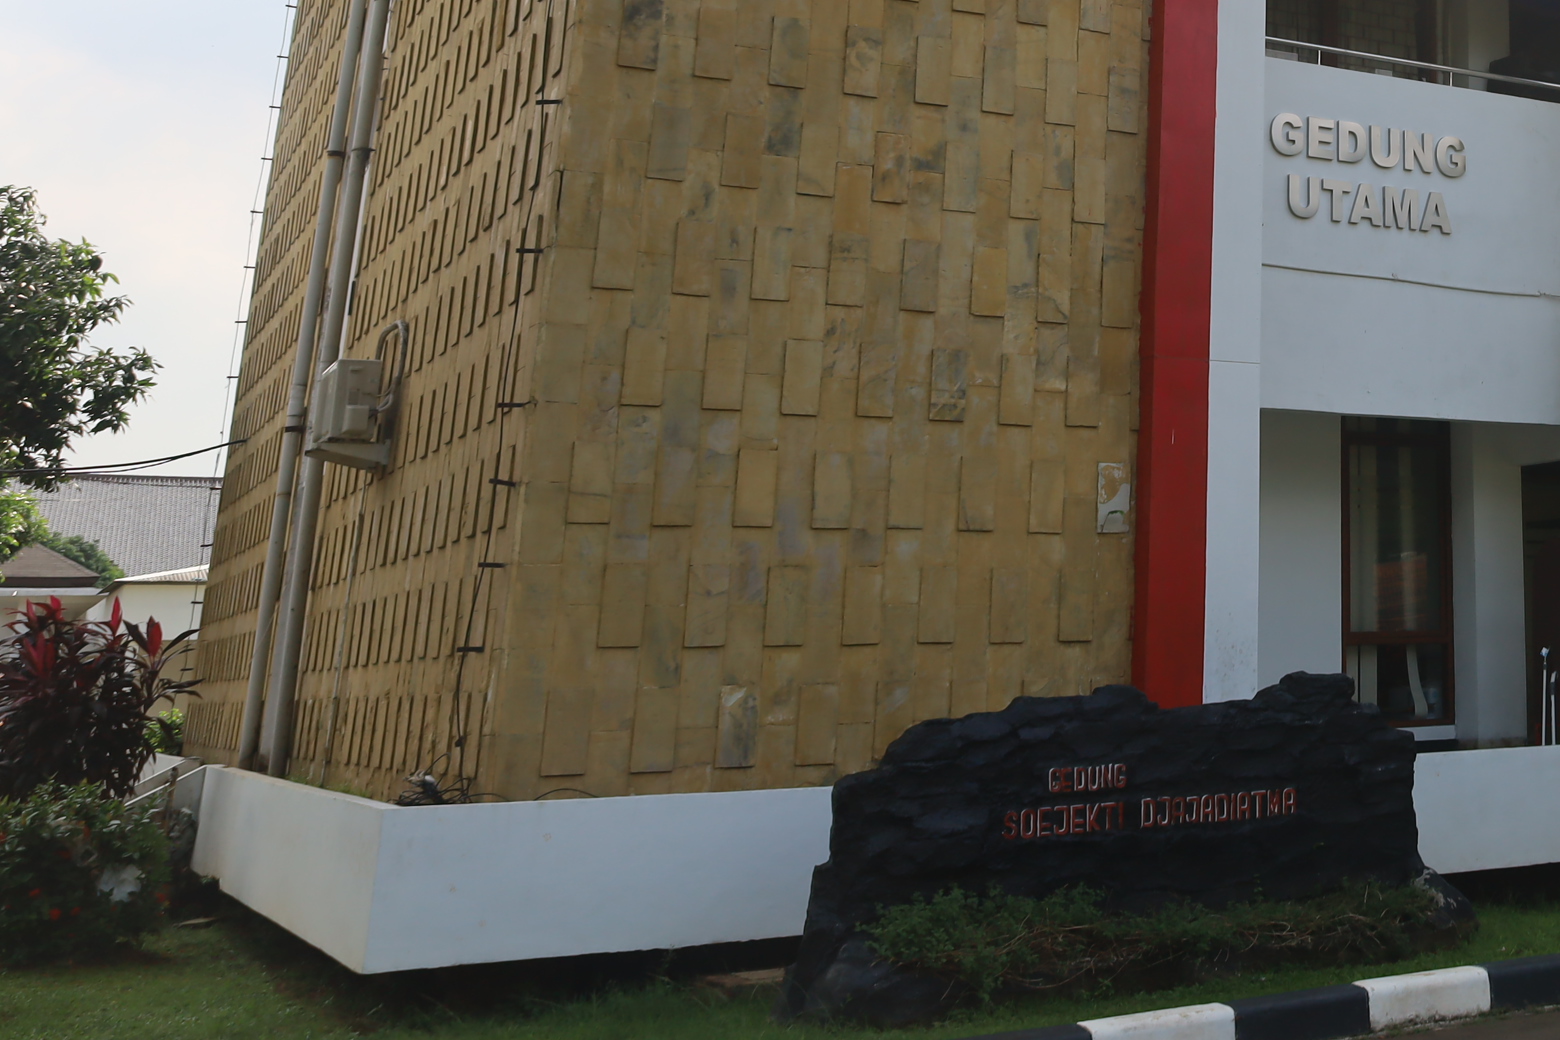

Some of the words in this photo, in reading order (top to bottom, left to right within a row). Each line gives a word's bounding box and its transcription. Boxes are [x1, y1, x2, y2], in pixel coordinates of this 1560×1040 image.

[1270, 112, 1467, 178] GEDUNG
[1287, 173, 1451, 235] UTAMA
[1048, 763, 1128, 793] GEDUNG
[1002, 801, 1125, 840] SOEJEKTI
[1140, 787, 1298, 829] DJAJADIATMA
